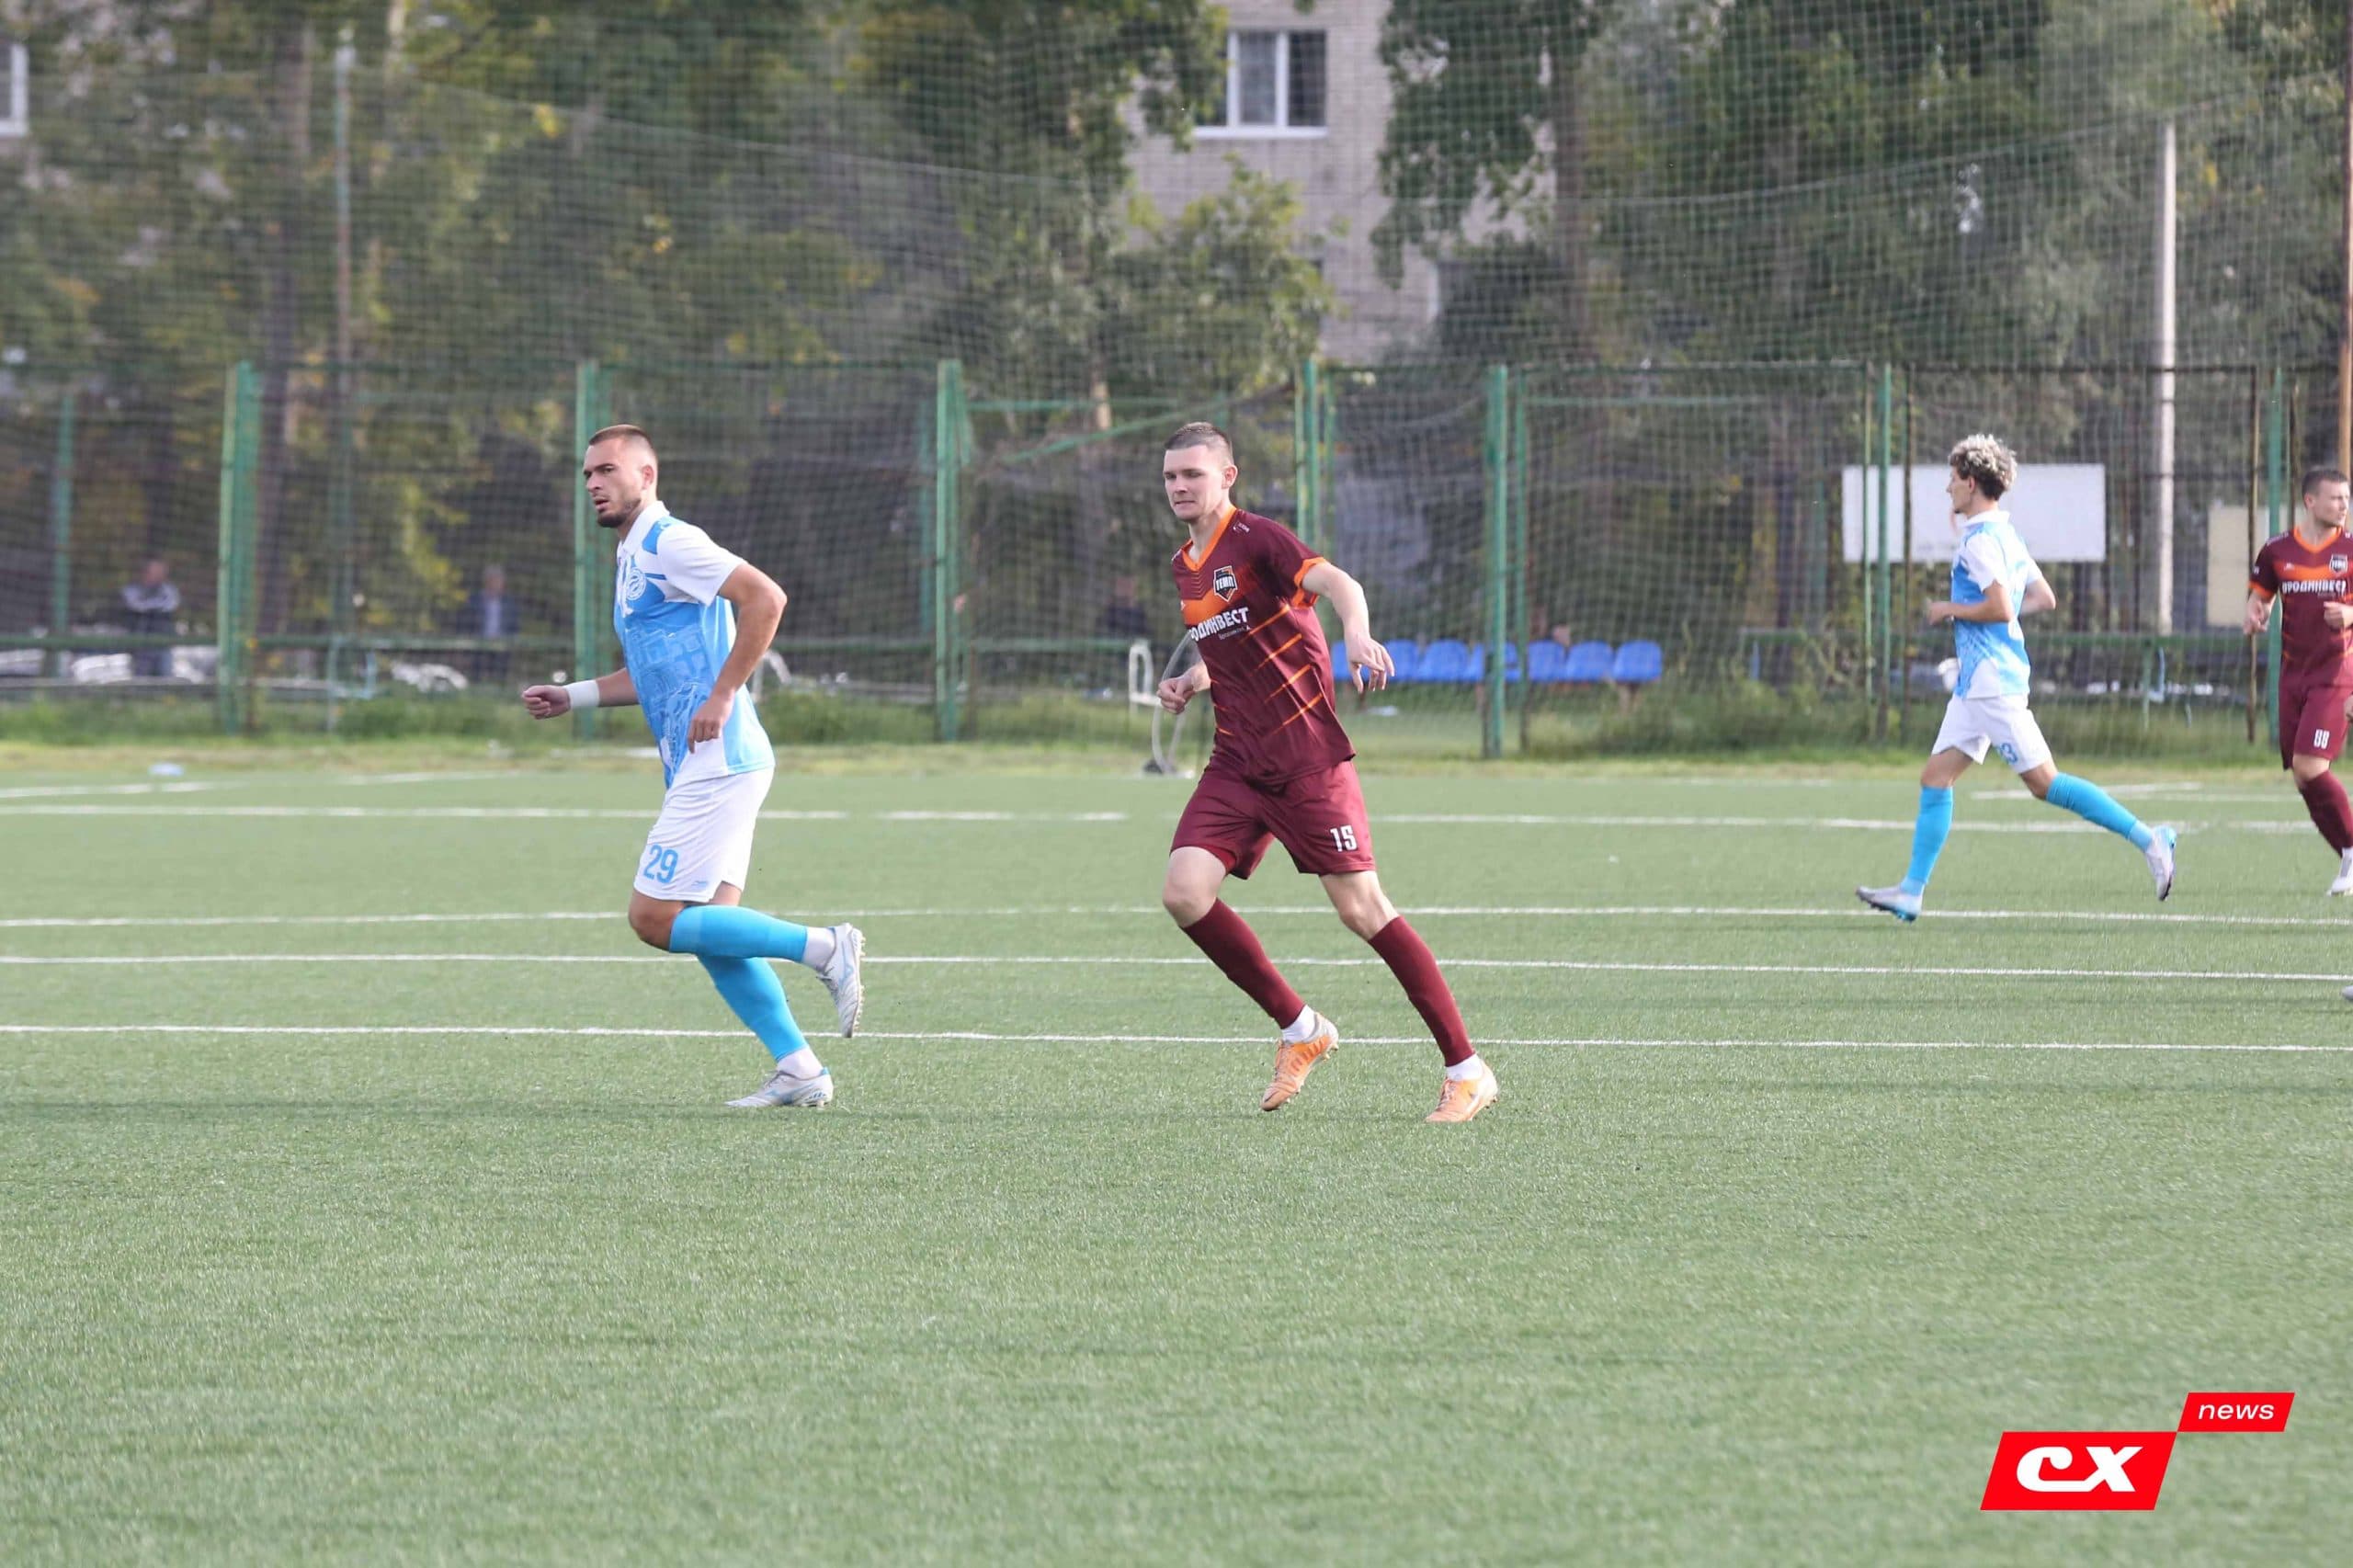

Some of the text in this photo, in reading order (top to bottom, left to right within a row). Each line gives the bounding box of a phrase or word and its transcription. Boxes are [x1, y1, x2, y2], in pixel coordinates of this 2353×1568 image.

[1215, 576, 1234, 591] ТЕМП
[1189, 607, 1249, 642] ОДИНВЕСТ
[1330, 825, 1358, 852] 15
[644, 844, 678, 883] 29
